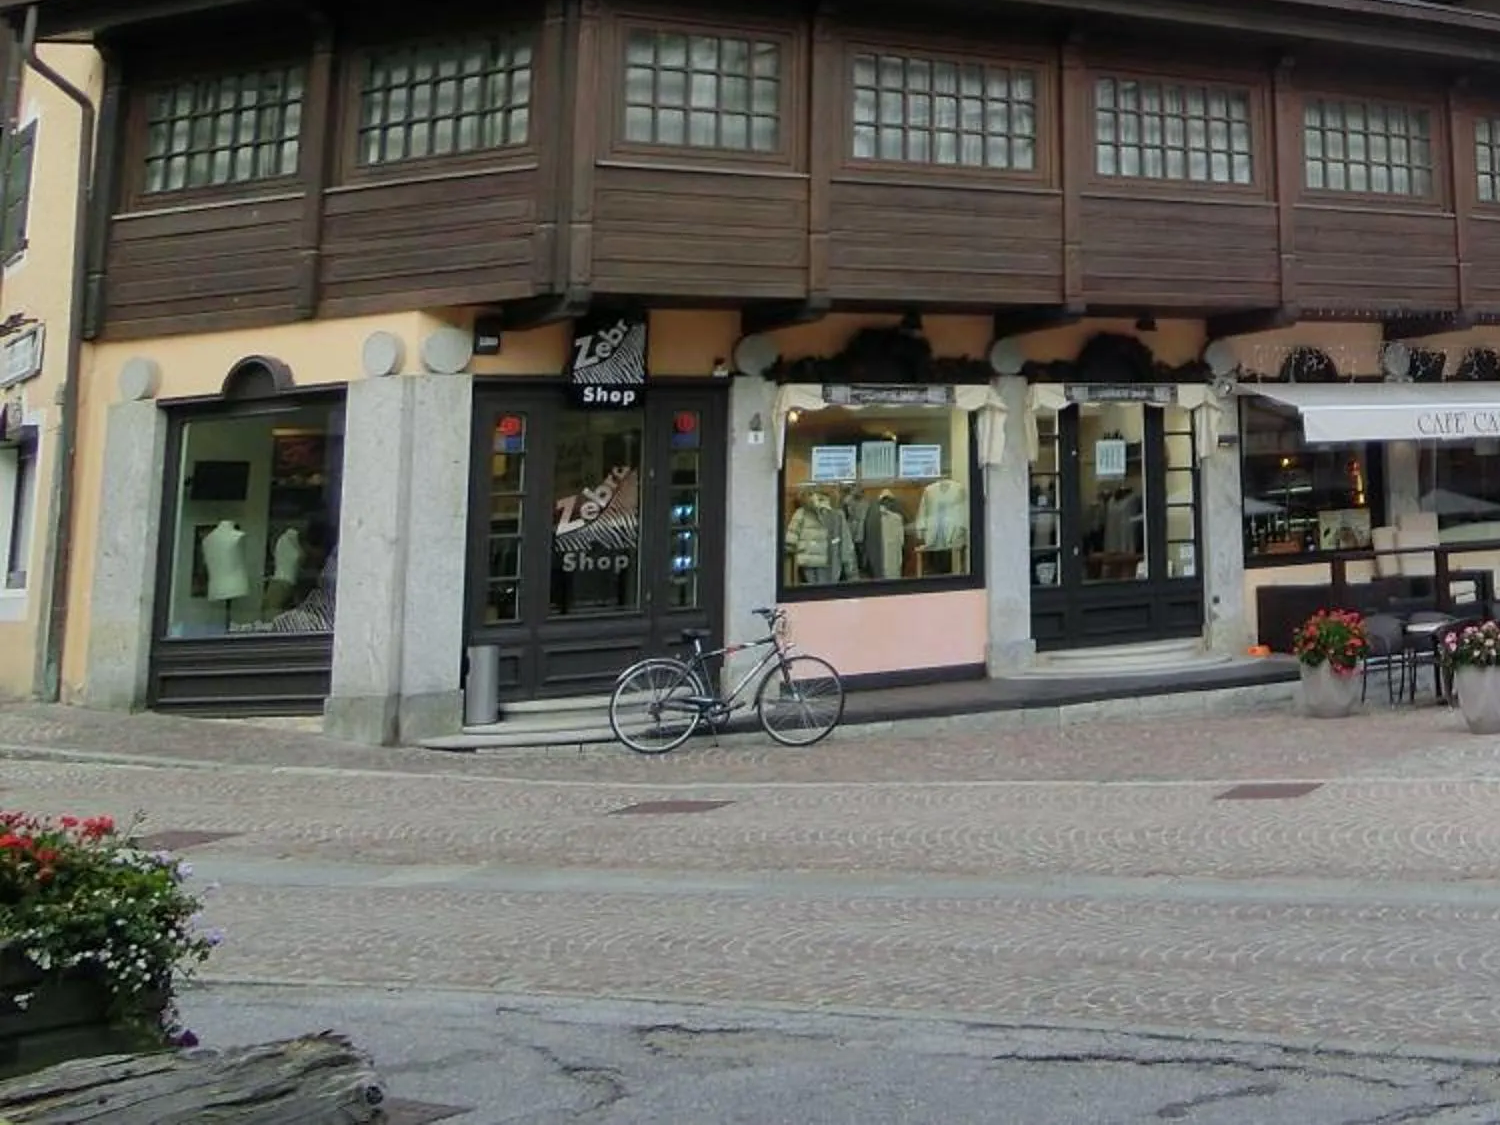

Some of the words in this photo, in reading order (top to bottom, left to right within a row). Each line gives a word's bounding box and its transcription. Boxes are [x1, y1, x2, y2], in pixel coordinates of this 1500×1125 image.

[583, 387, 635, 406] Shop
[555, 465, 631, 535] Zebra
[562, 554, 630, 572] Shop
